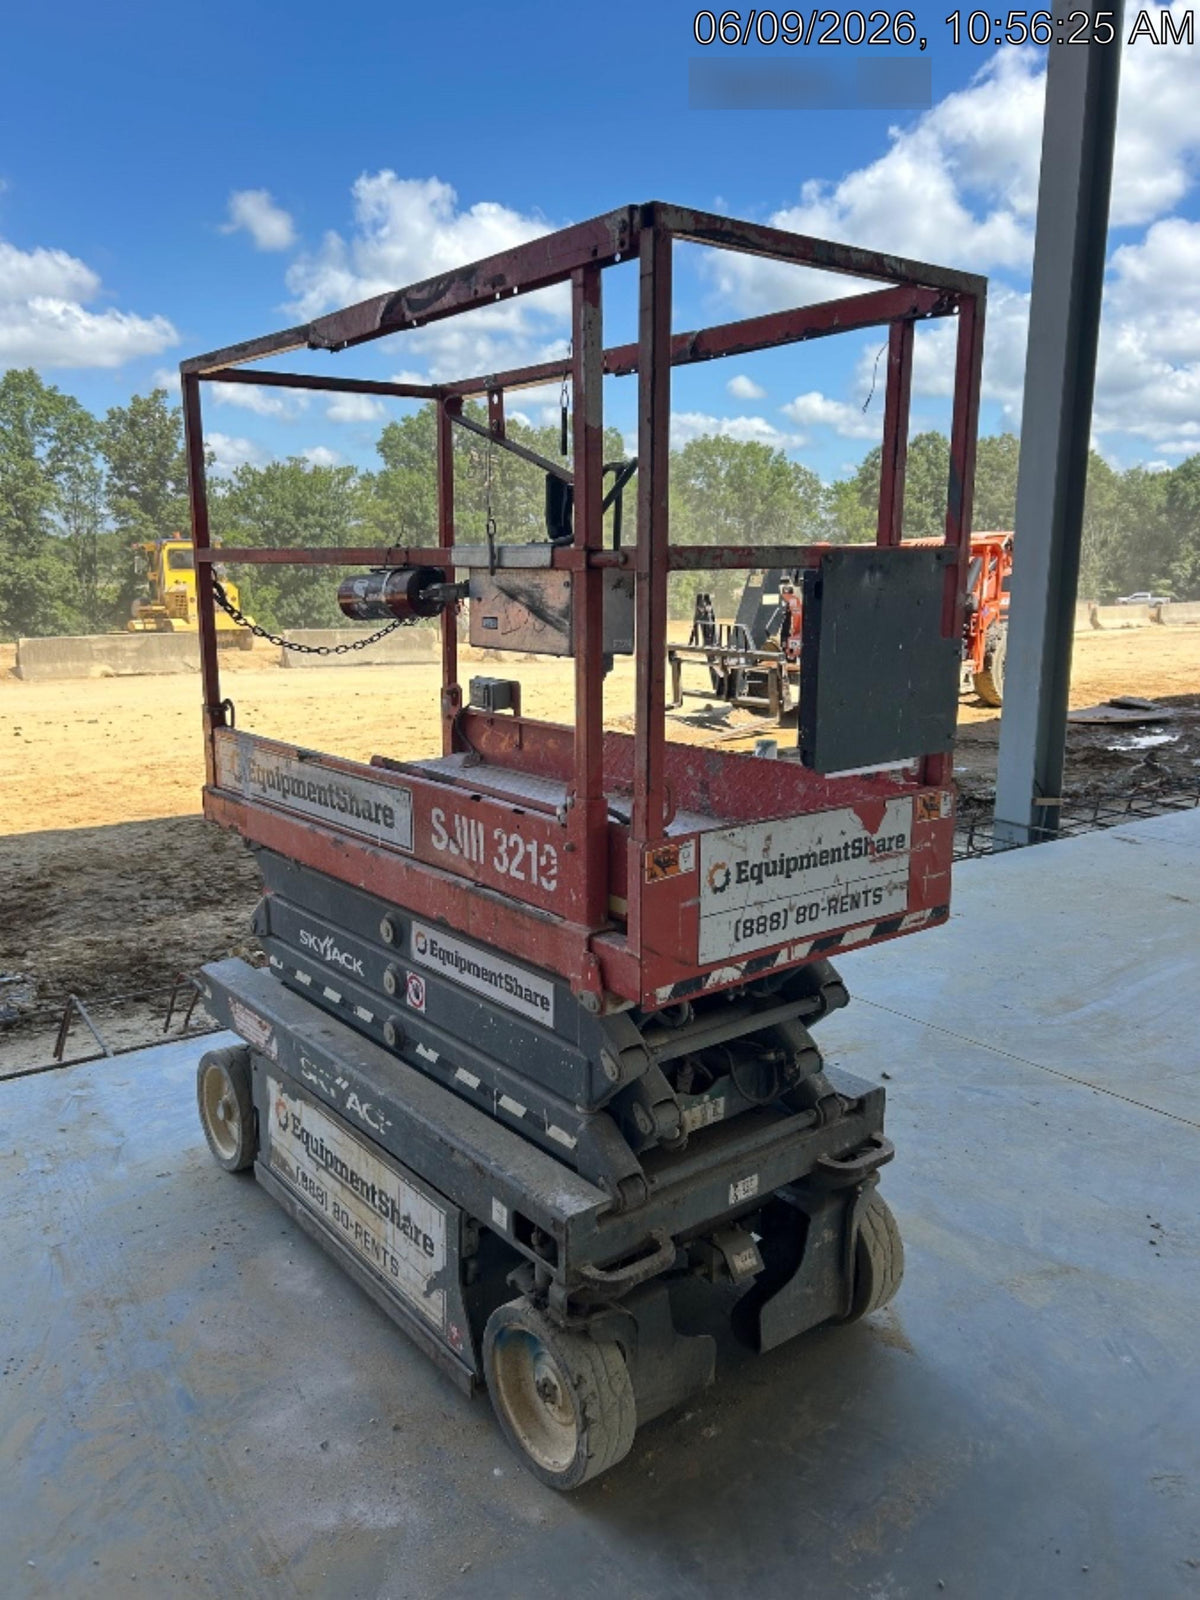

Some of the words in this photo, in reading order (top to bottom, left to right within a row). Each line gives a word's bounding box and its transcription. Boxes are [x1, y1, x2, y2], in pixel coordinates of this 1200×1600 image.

[734, 908, 788, 942] (888)
[795, 886, 883, 924] 80-RENTS
[300, 929, 365, 977] SKYJACK
[429, 938, 551, 1012] EquipmentShare
[291, 1113, 435, 1258] EquipmentShare
